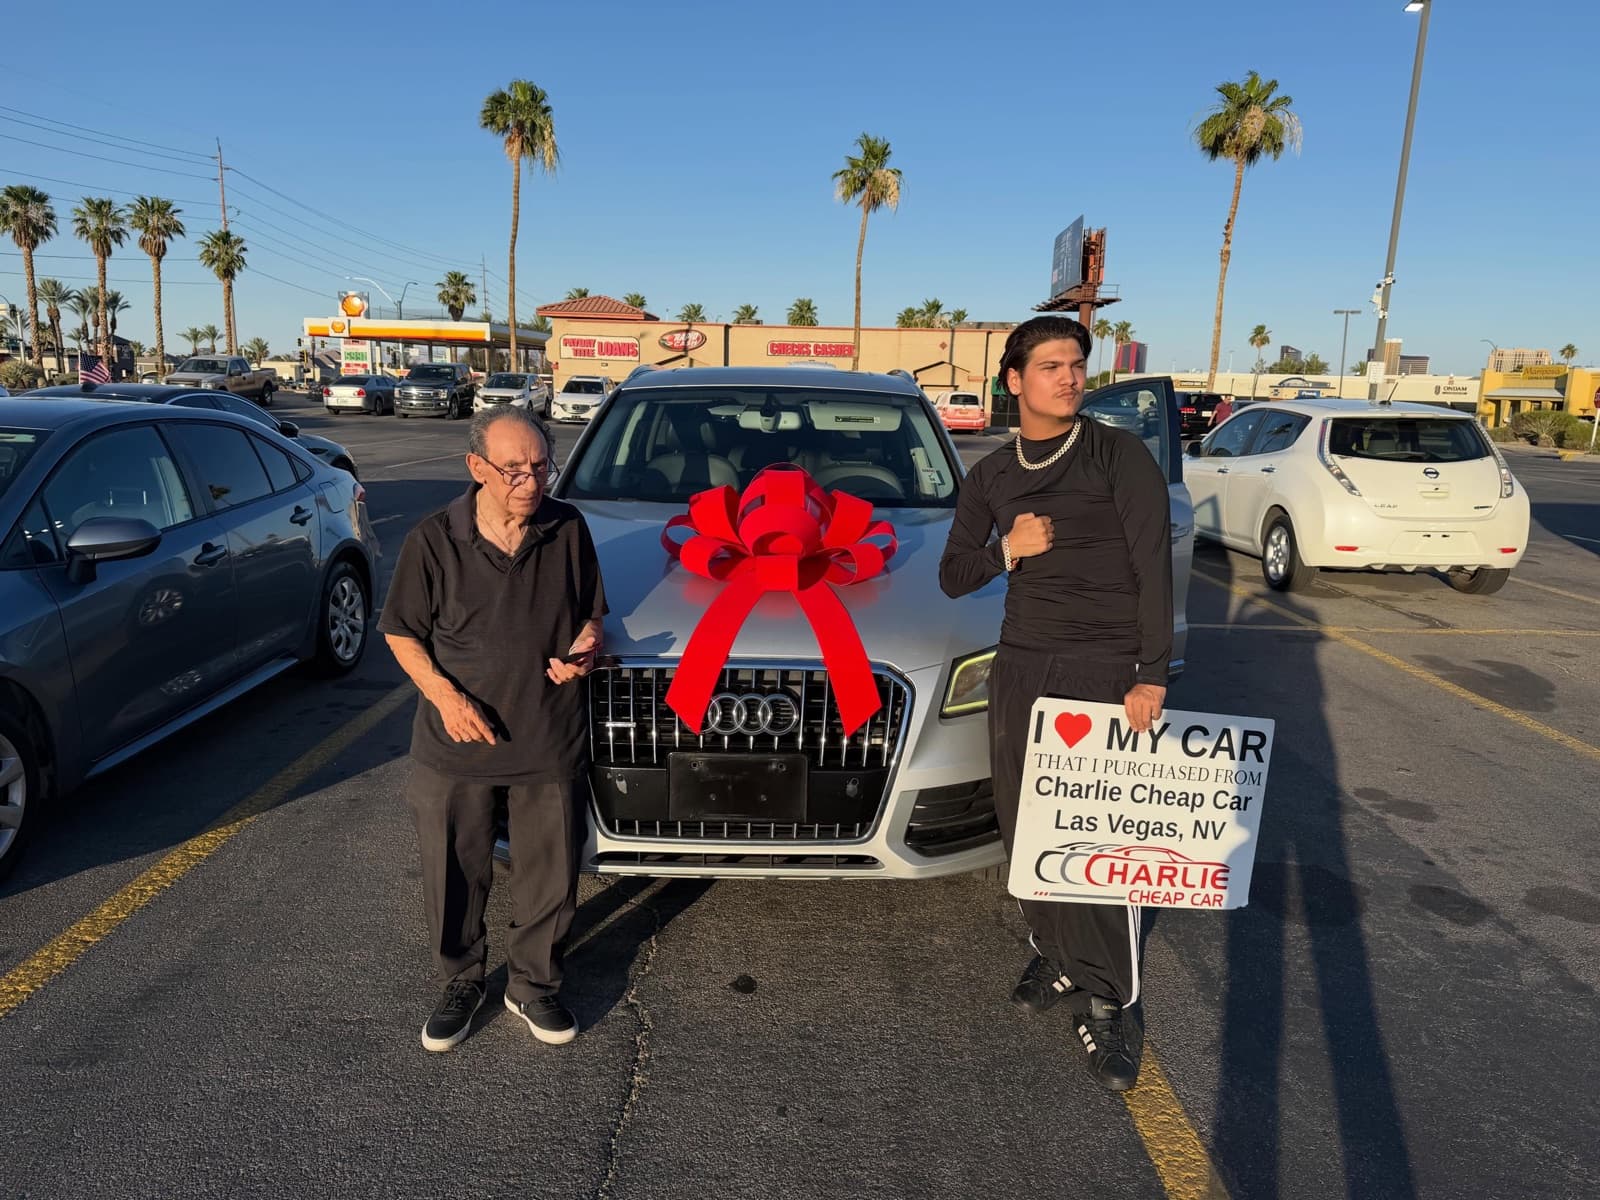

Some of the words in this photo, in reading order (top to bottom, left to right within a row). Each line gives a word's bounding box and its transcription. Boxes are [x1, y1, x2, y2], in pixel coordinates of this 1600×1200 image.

[597, 341, 639, 358] LOANS
[769, 343, 812, 356] CHECKS
[1034, 710, 1045, 744] I
[1106, 717, 1171, 754] MY
[1181, 724, 1267, 763] CAR
[1034, 753, 1088, 772] THAT
[1092, 758, 1099, 773] I
[1104, 759, 1210, 782] PURCHASED
[1214, 768, 1262, 786] FROM
[1035, 775, 1122, 801] Charlie
[1130, 784, 1205, 813] Cheap
[1213, 790, 1253, 812] Car
[1054, 809, 1098, 832] Las
[1107, 813, 1184, 842] Vegas,
[1192, 819, 1227, 841] NV
[1128, 889, 1185, 905] CHEAP
[1190, 892, 1224, 908] CAR
